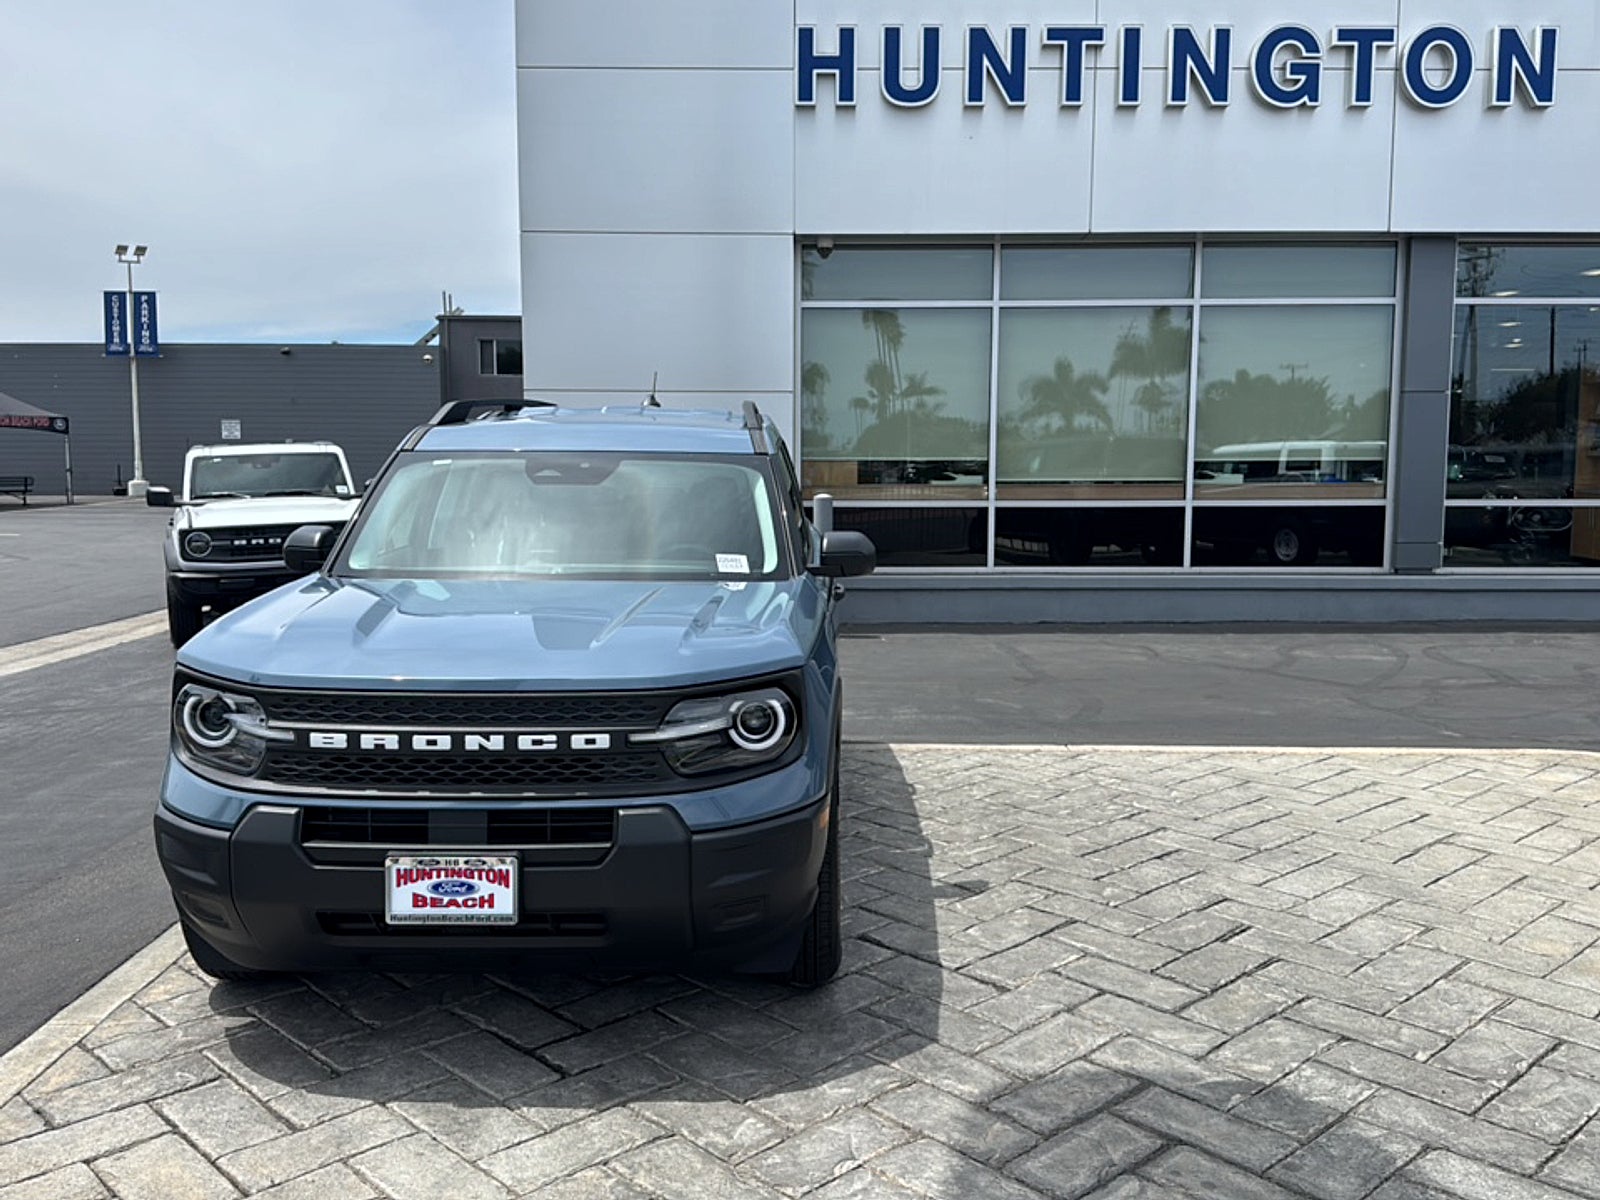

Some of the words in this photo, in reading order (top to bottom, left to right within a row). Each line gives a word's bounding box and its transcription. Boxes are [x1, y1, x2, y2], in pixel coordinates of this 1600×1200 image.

[795, 24, 1559, 106] HUNTINGTON
[111, 295, 120, 345] CUSTOMER
[141, 295, 150, 345] PARKING
[309, 732, 611, 751] BRONCO
[396, 867, 510, 889] HUNTINGTON
[438, 882, 469, 894] Ford
[412, 892, 495, 909] BEACH
